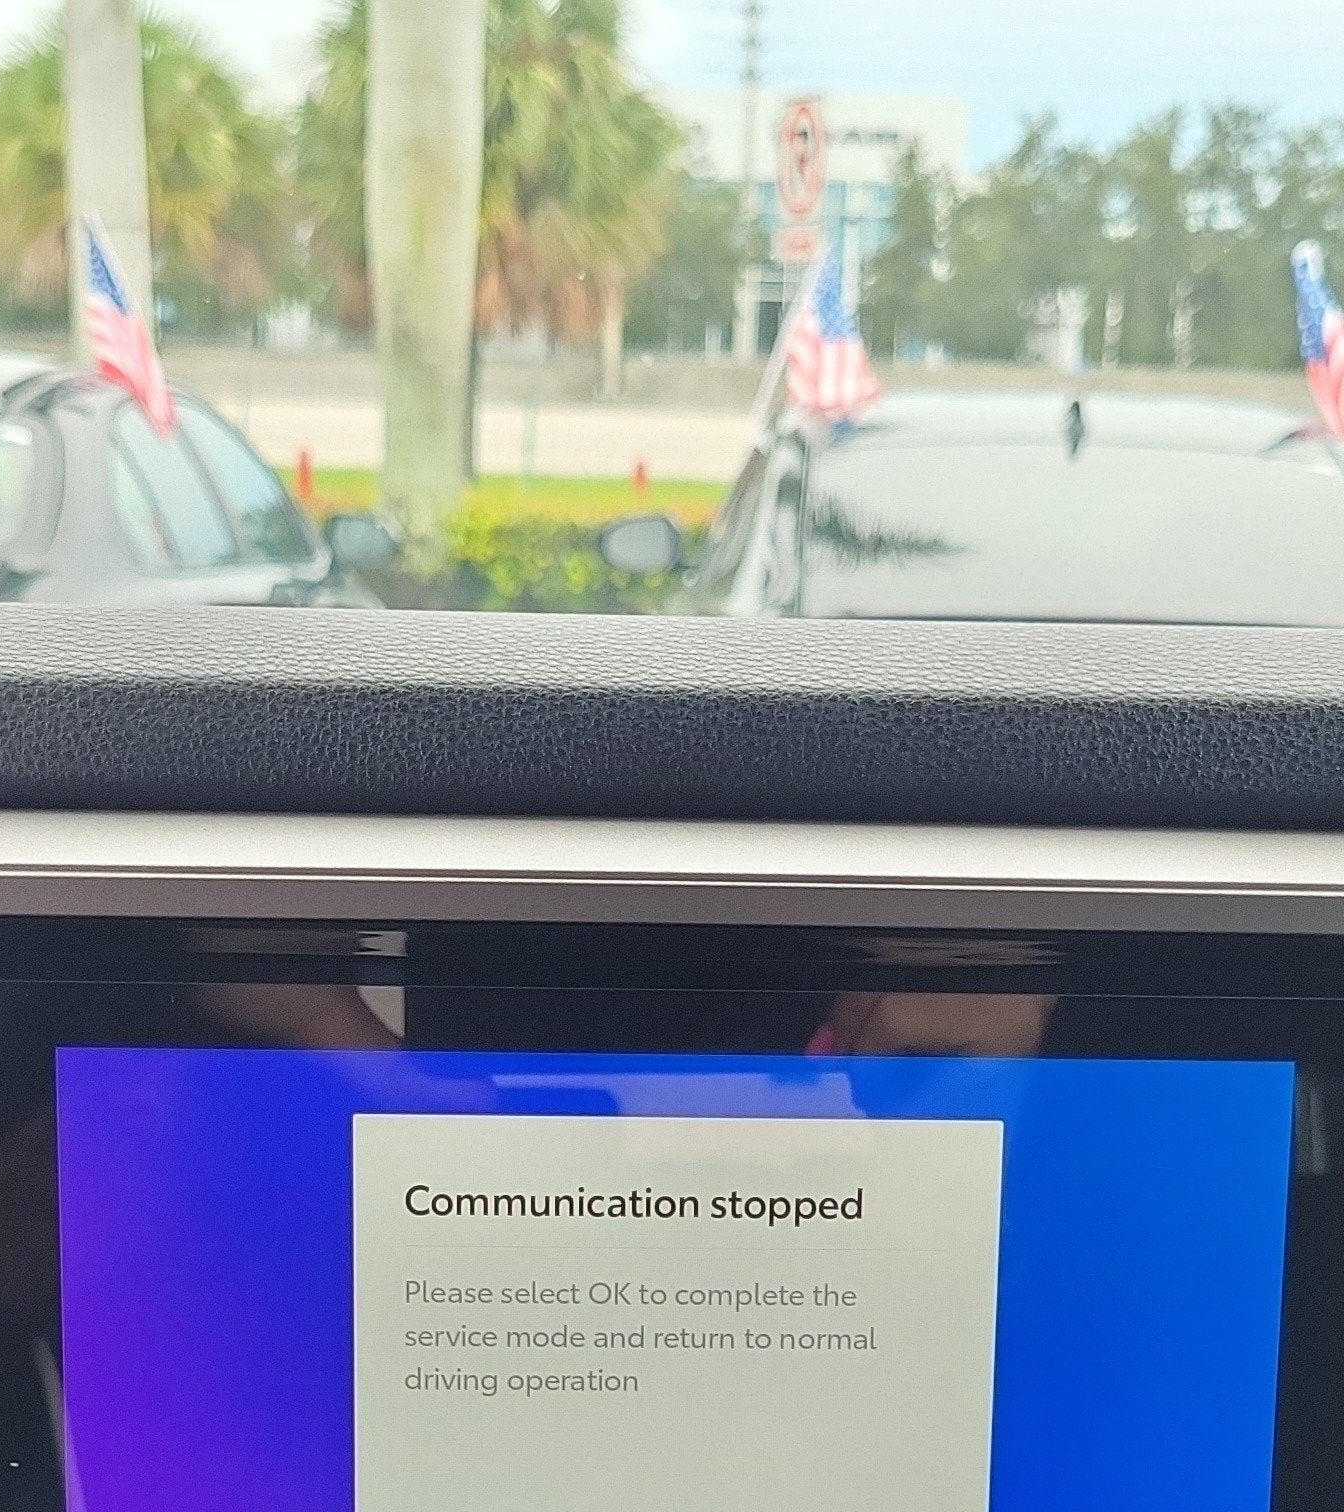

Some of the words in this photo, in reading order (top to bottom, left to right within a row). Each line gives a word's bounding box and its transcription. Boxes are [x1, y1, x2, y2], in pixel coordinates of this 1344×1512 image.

[405, 1184, 699, 1219] Communication
[710, 1187, 864, 1228] stopped
[405, 1279, 494, 1305] Please
[500, 1280, 581, 1305] select
[588, 1282, 632, 1305] OK
[638, 1284, 668, 1305] to
[674, 1282, 805, 1313] complete
[812, 1282, 858, 1307] the
[404, 1324, 498, 1349] service
[506, 1324, 586, 1348] mode
[593, 1325, 646, 1349] and
[654, 1327, 736, 1350] return
[744, 1328, 773, 1350] to
[780, 1326, 878, 1351] normal
[404, 1365, 498, 1397] driving
[507, 1367, 640, 1398] operation
